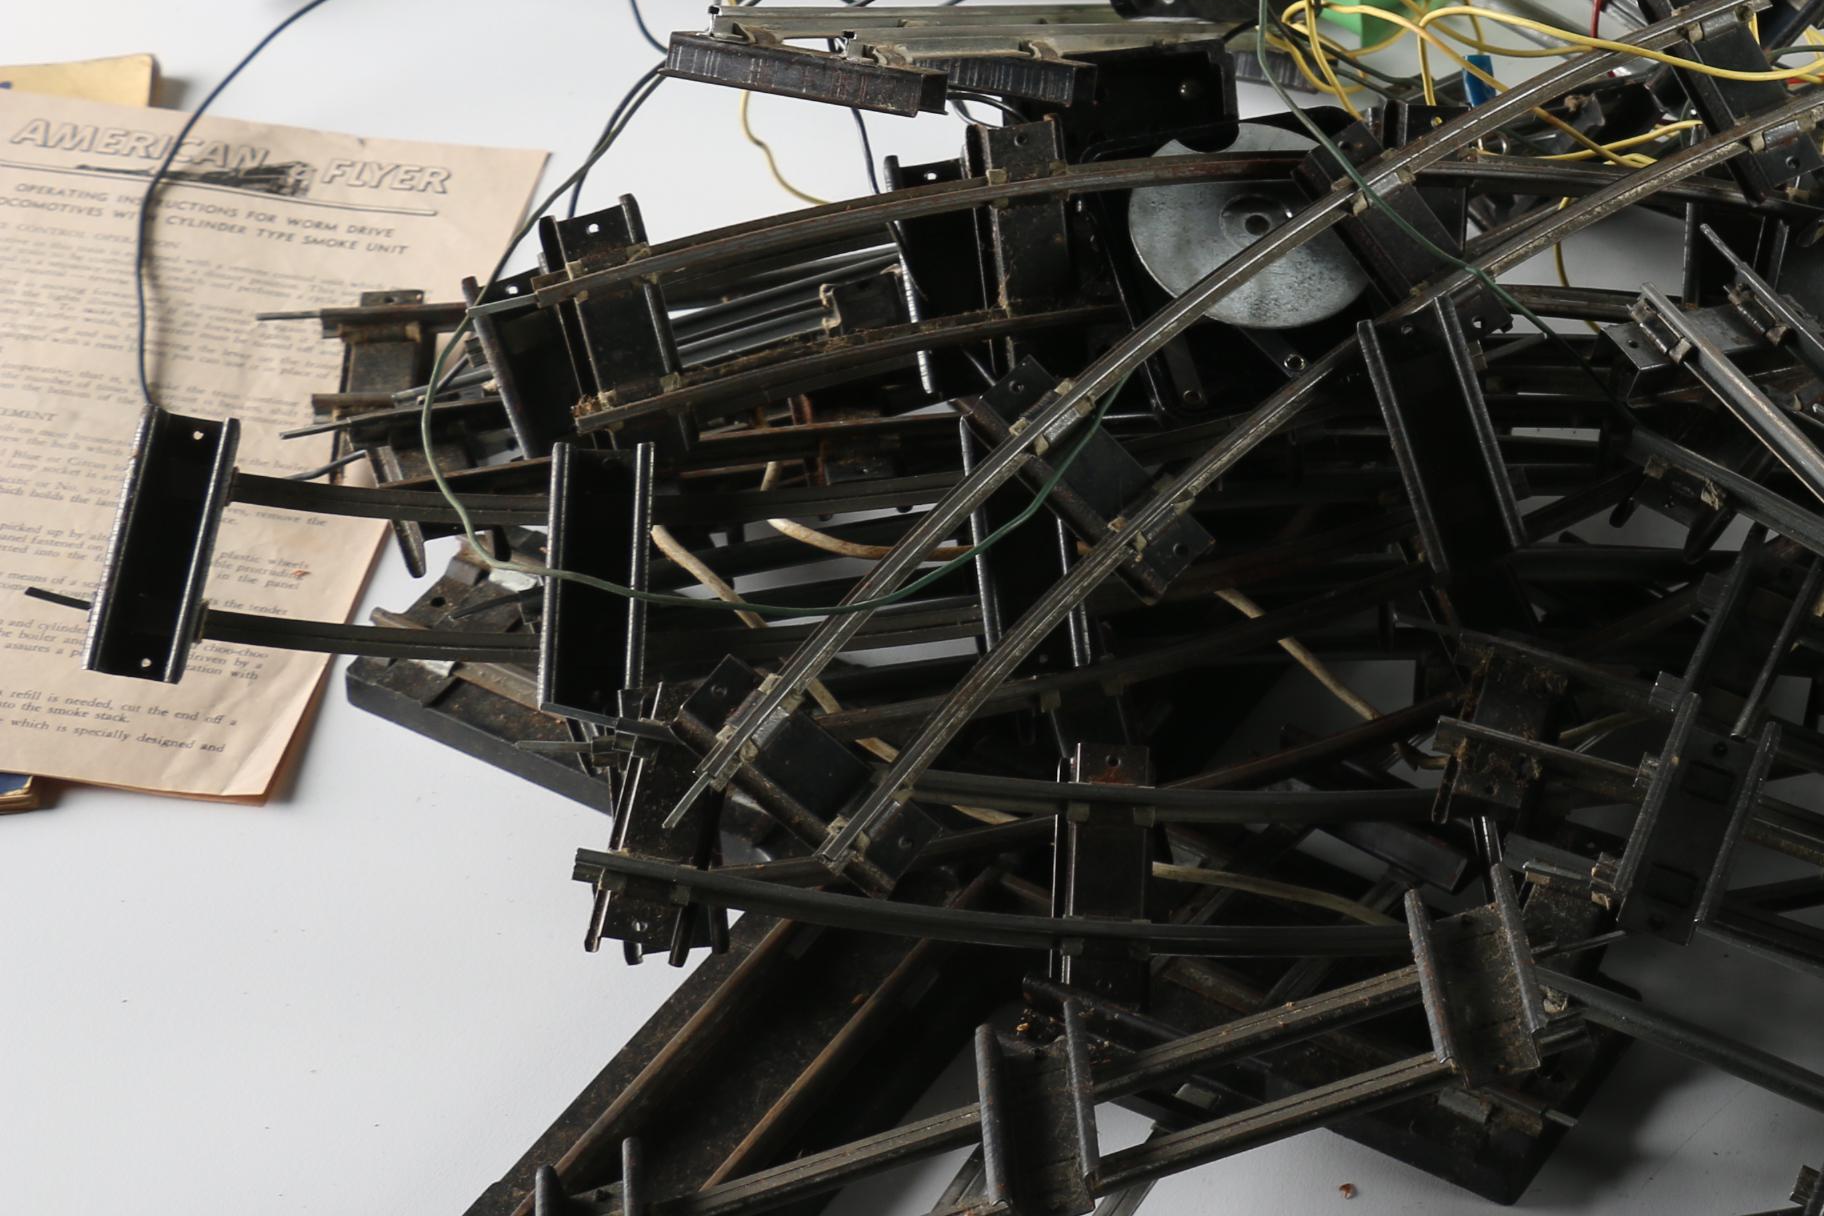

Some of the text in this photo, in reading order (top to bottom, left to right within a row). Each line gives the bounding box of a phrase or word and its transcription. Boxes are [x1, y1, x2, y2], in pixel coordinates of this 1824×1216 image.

[10, 117, 452, 195] AMERICAN FLYER
[0, 195, 409, 255] OCOMOTIVES CYLINDER TYPE SMOKE UNIT
[15, 182, 396, 239] OPERATING FOR WORM DRIVE
[37, 622, 90, 635] cylinde
[231, 669, 259, 681] with
[234, 657, 250, 669] by
[21, 700, 43, 713] the
[46, 704, 90, 719] smoke
[94, 710, 131, 724] stack.
[47, 692, 59, 703] is
[65, 695, 114, 711] needed,
[120, 702, 142, 714] cut
[147, 704, 170, 717] the
[174, 709, 199, 722] end
[203, 713, 225, 726] off
[229, 719, 238, 727] a
[10, 717, 227, 754] which is specially designed and
